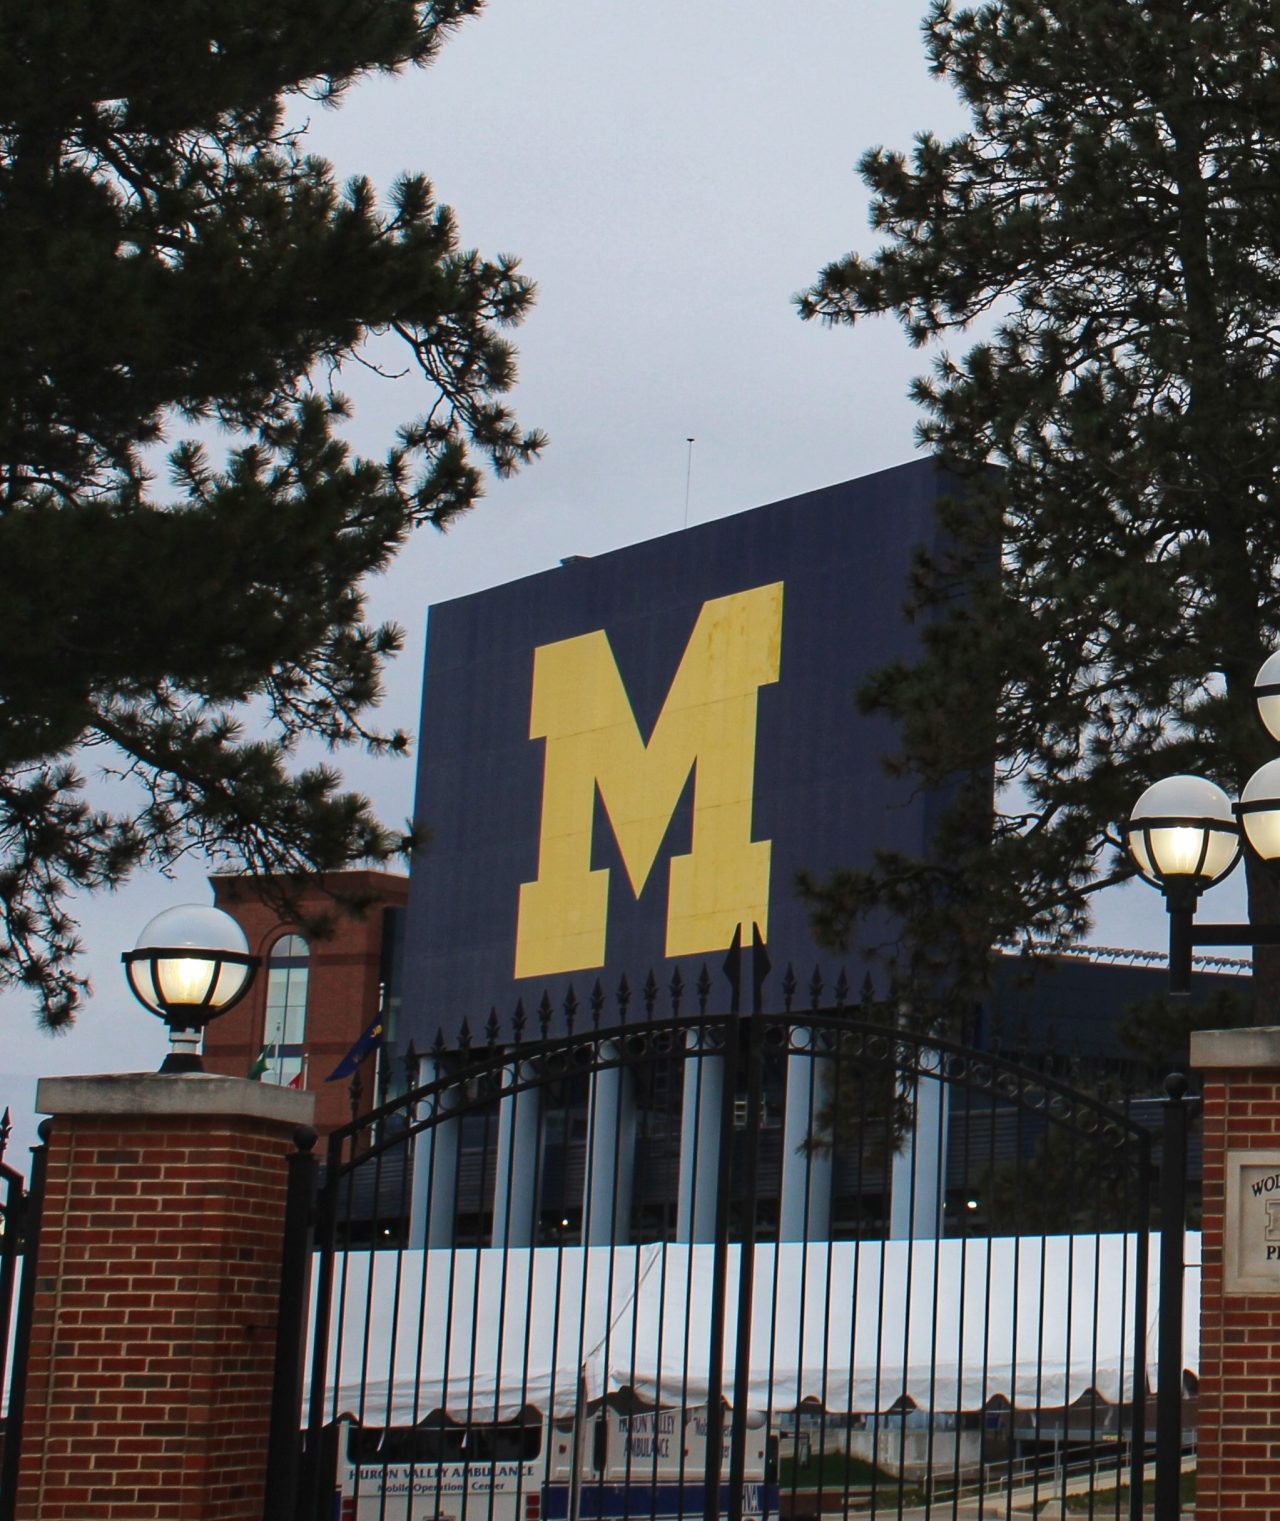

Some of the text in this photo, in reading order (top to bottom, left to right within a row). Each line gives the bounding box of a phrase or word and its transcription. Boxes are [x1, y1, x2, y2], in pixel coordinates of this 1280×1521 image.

[514, 581, 784, 979] M
[412, 1481, 465, 1495] Opertion
[471, 1479, 505, 1491] Cener
